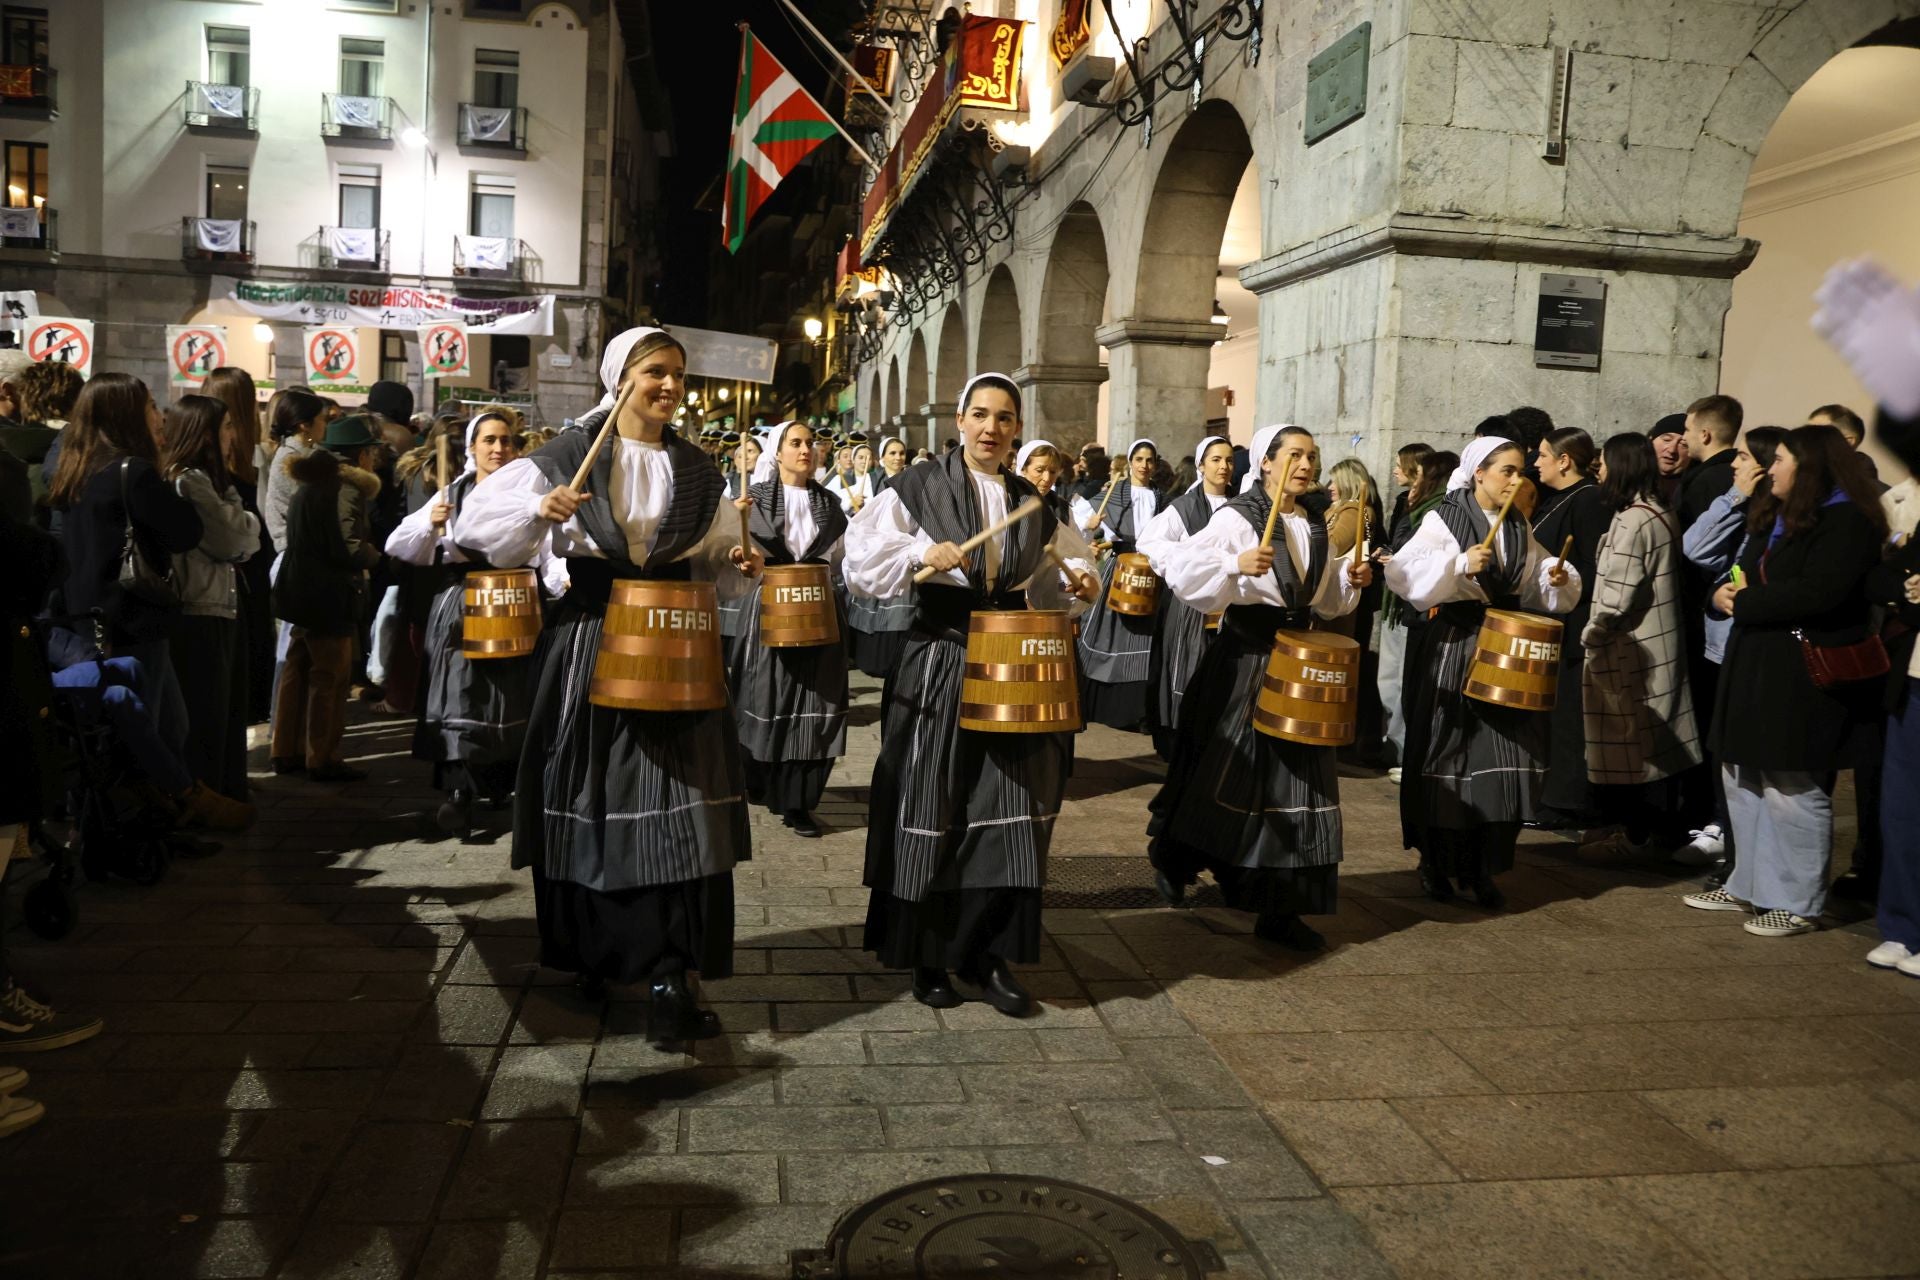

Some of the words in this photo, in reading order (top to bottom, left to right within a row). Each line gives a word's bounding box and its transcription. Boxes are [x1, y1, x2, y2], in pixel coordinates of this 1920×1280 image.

[1119, 571, 1156, 588] ITSASI
[476, 588, 531, 606] ITSASI
[776, 586, 825, 604] ITSASI
[648, 608, 712, 632] ITSASI
[1021, 638, 1068, 657] ITSASI
[1301, 665, 1347, 685] ITSASI
[871, 1187, 1141, 1245] IBERDROLA
